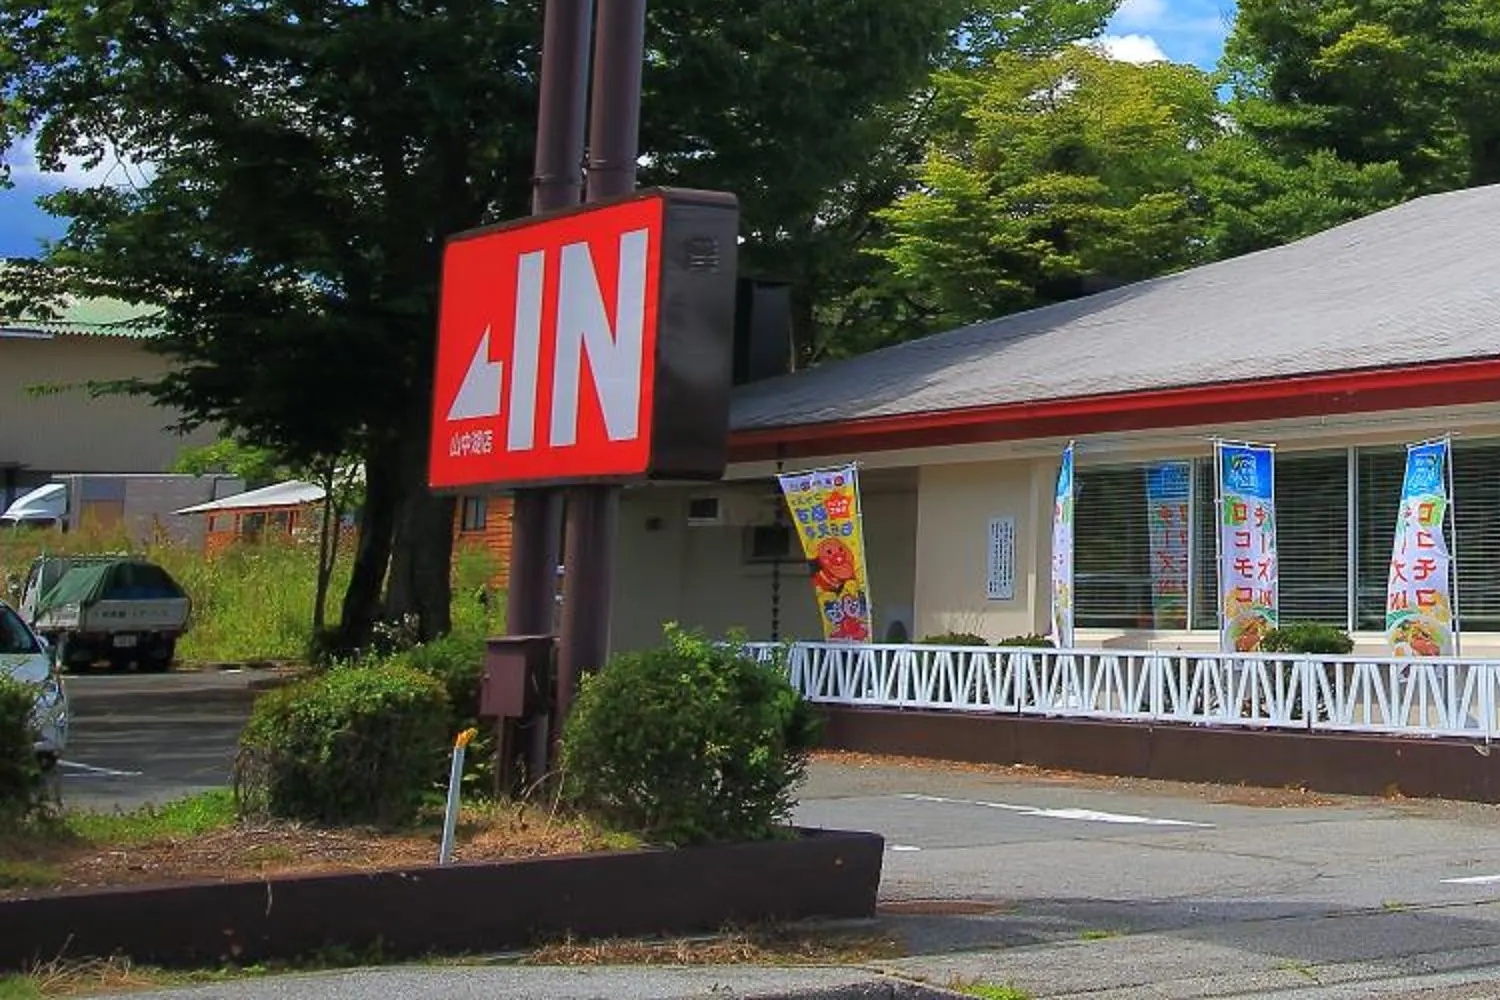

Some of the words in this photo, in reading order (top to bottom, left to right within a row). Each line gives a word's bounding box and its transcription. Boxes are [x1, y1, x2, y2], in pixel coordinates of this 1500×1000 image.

[507, 227, 648, 451] IN
[1232, 502, 1254, 606] ロコモコ
